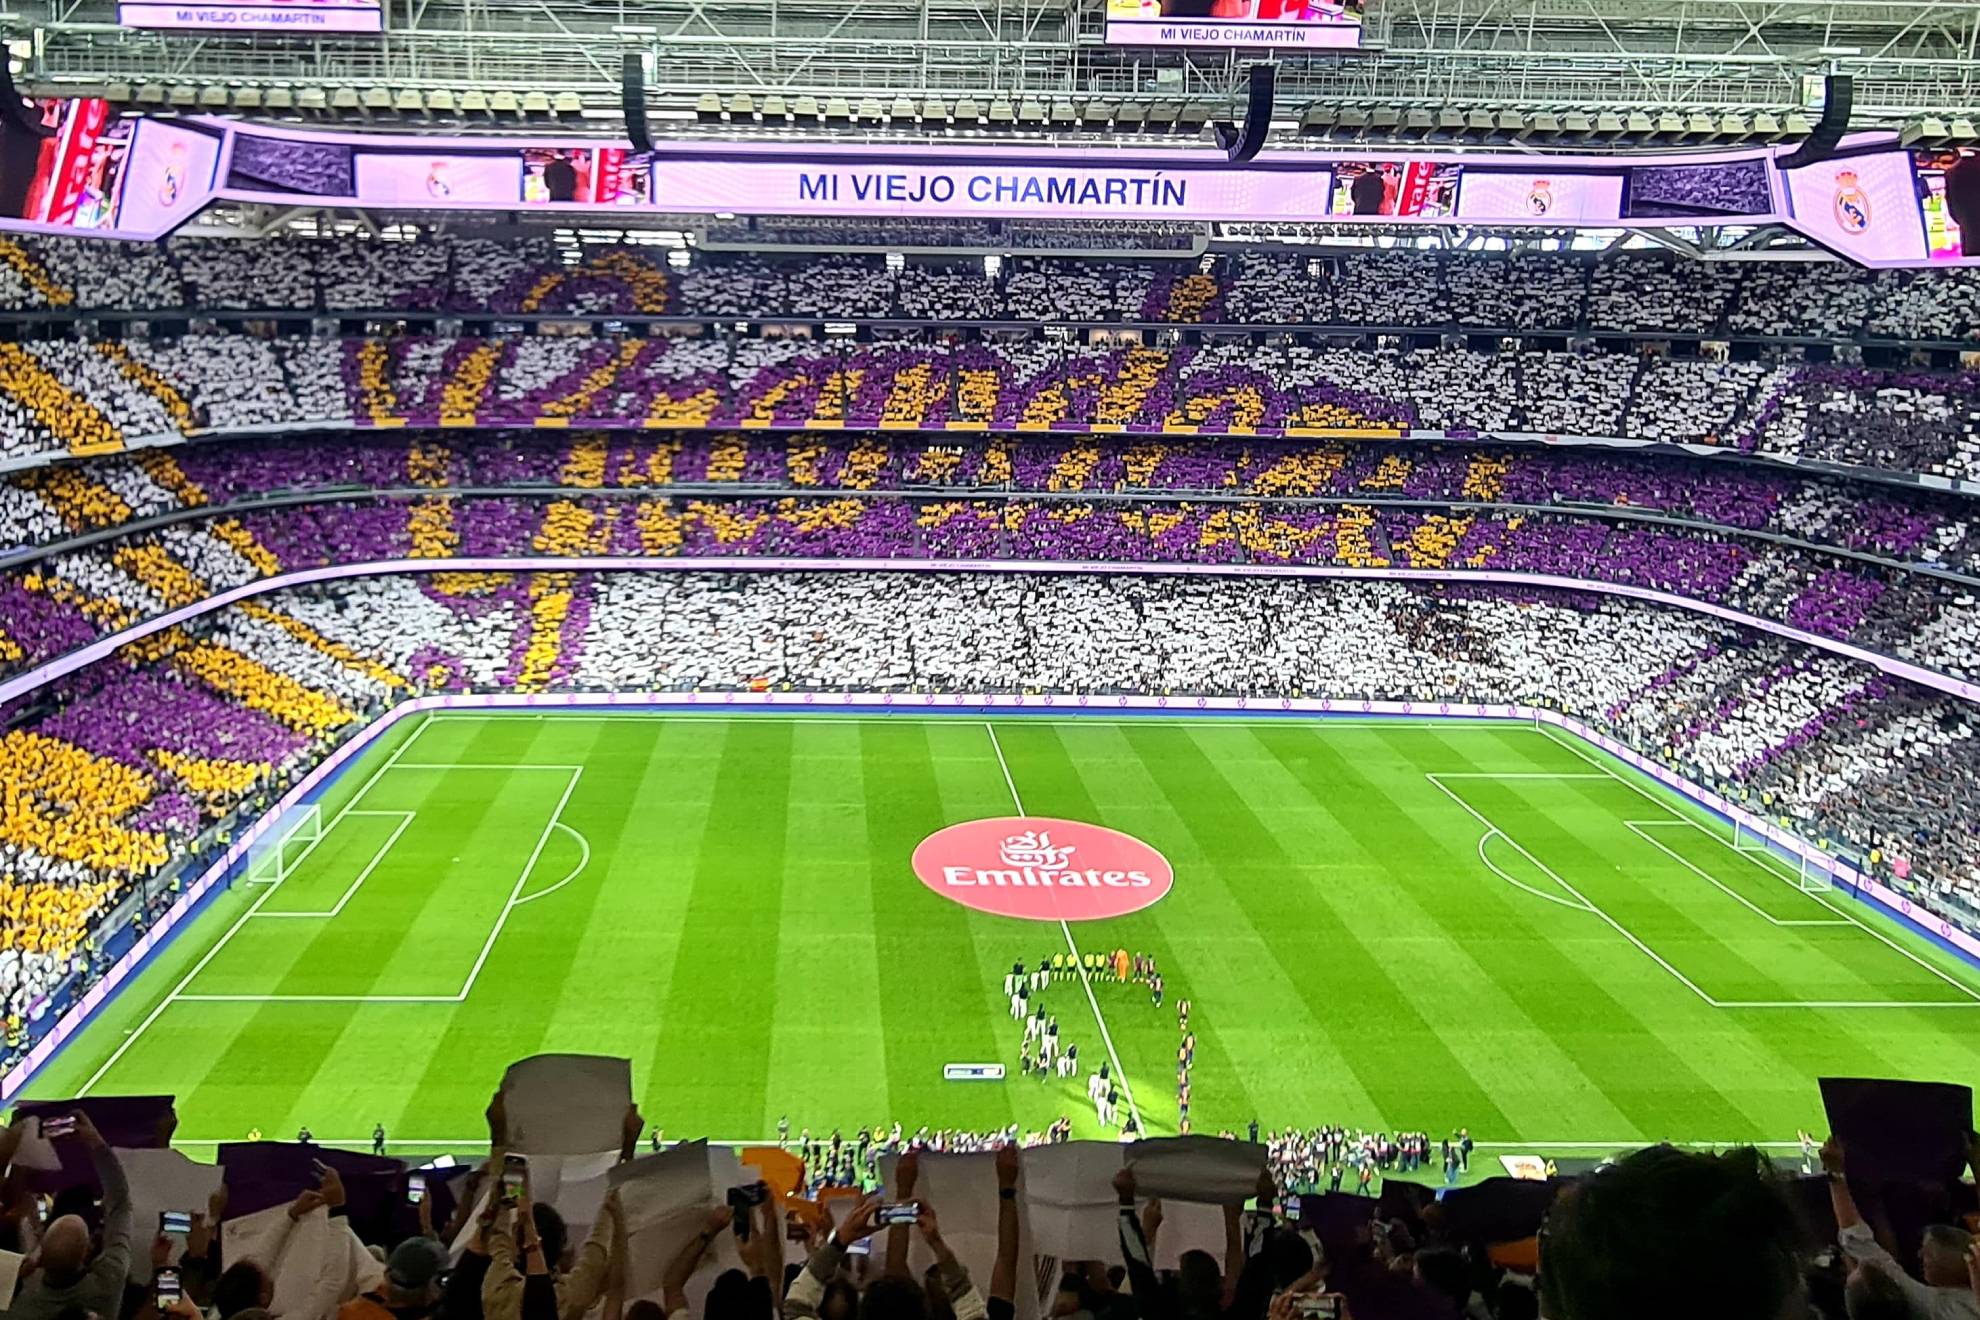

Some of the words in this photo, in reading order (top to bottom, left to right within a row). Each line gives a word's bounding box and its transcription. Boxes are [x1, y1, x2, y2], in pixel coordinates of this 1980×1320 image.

[176, 11, 193, 21] MI
[196, 11, 237, 23] VIEJO
[1160, 28, 1176, 39] MI
[1180, 28, 1220, 40] VIEJO
[1223, 27, 1306, 42] CHAMARTÍN
[799, 173, 838, 201] MI
[851, 174, 955, 202] VIEJO
[967, 172, 1187, 206] CHAMARTÍN
[942, 866, 1152, 888] Emirates
